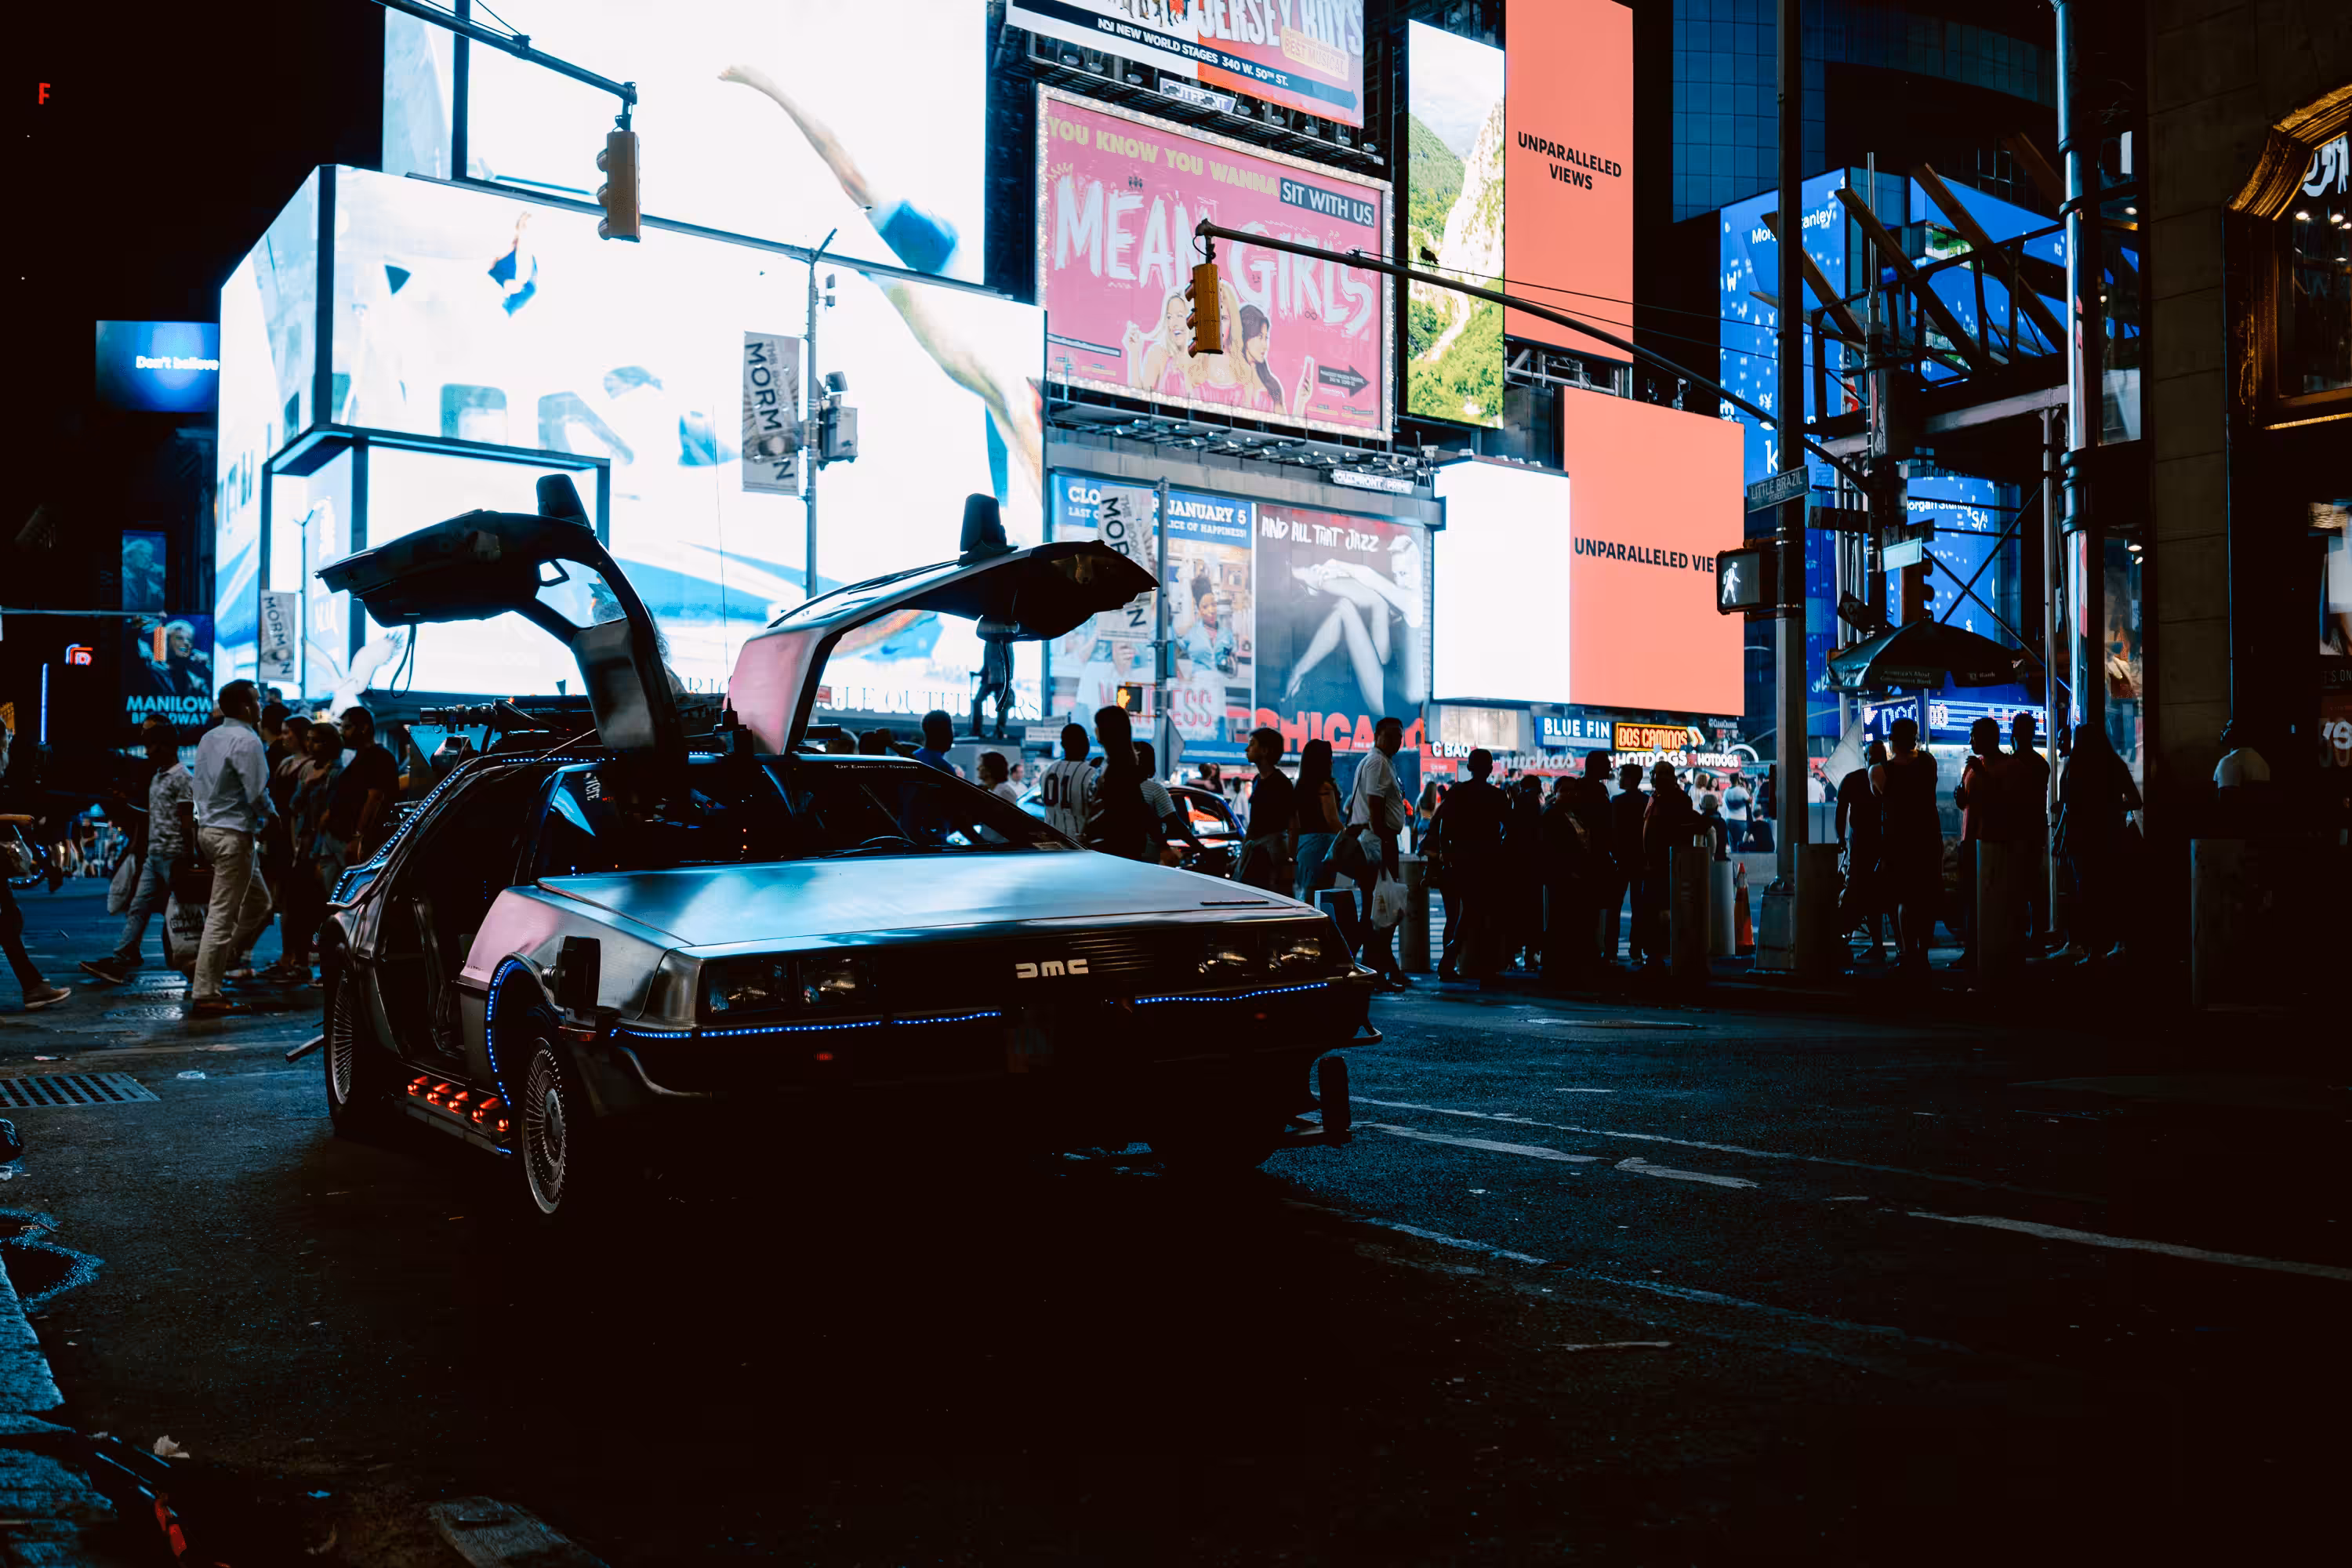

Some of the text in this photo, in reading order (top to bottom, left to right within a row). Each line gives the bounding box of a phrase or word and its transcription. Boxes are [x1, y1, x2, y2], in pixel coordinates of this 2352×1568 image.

[1116, 23, 1142, 40] NEW
[1143, 31, 1181, 52] WORLD
[1182, 44, 1218, 64] STAGES
[1222, 56, 1240, 71] 340
[1242, 62, 1254, 76] W.
[1276, 74, 1288, 86] ST.
[1285, 38, 1305, 59] BEST
[1308, 48, 1345, 75] MUSICAL
[1047, 116, 1089, 145] YOU
[1097, 131, 1159, 163] KNOW
[1164, 148, 1203, 175] YOU
[1209, 161, 1279, 197] WANNA
[1282, 181, 1305, 205] SIT
[1308, 189, 1348, 218] WITH
[1518, 131, 1622, 178] UNPARALLELED
[1549, 163, 1593, 191] VIEWS
[1054, 176, 1373, 336] MEAN GIRLS
[1750, 470, 1802, 499] LITTLE BRAZIL
[1769, 491, 1785, 503] STREET
[1068, 506, 1091, 518] LAST
[1186, 522, 1199, 532] OF
[1167, 499, 1234, 523] JANUARY
[1237, 510, 1247, 525] 5
[1261, 515, 1381, 552] AND ALL THAT JAZZ
[1574, 536, 1717, 573] UNPARALLELED VIE
[126, 695, 213, 713] MANILOW
[1255, 708, 1425, 753] CHICAO
[1544, 717, 1610, 738] BLUE FIN
[1619, 727, 1640, 747] DOS
[1642, 728, 1687, 749] CAMINOS
[1697, 753, 1739, 768] HOTDOGS
